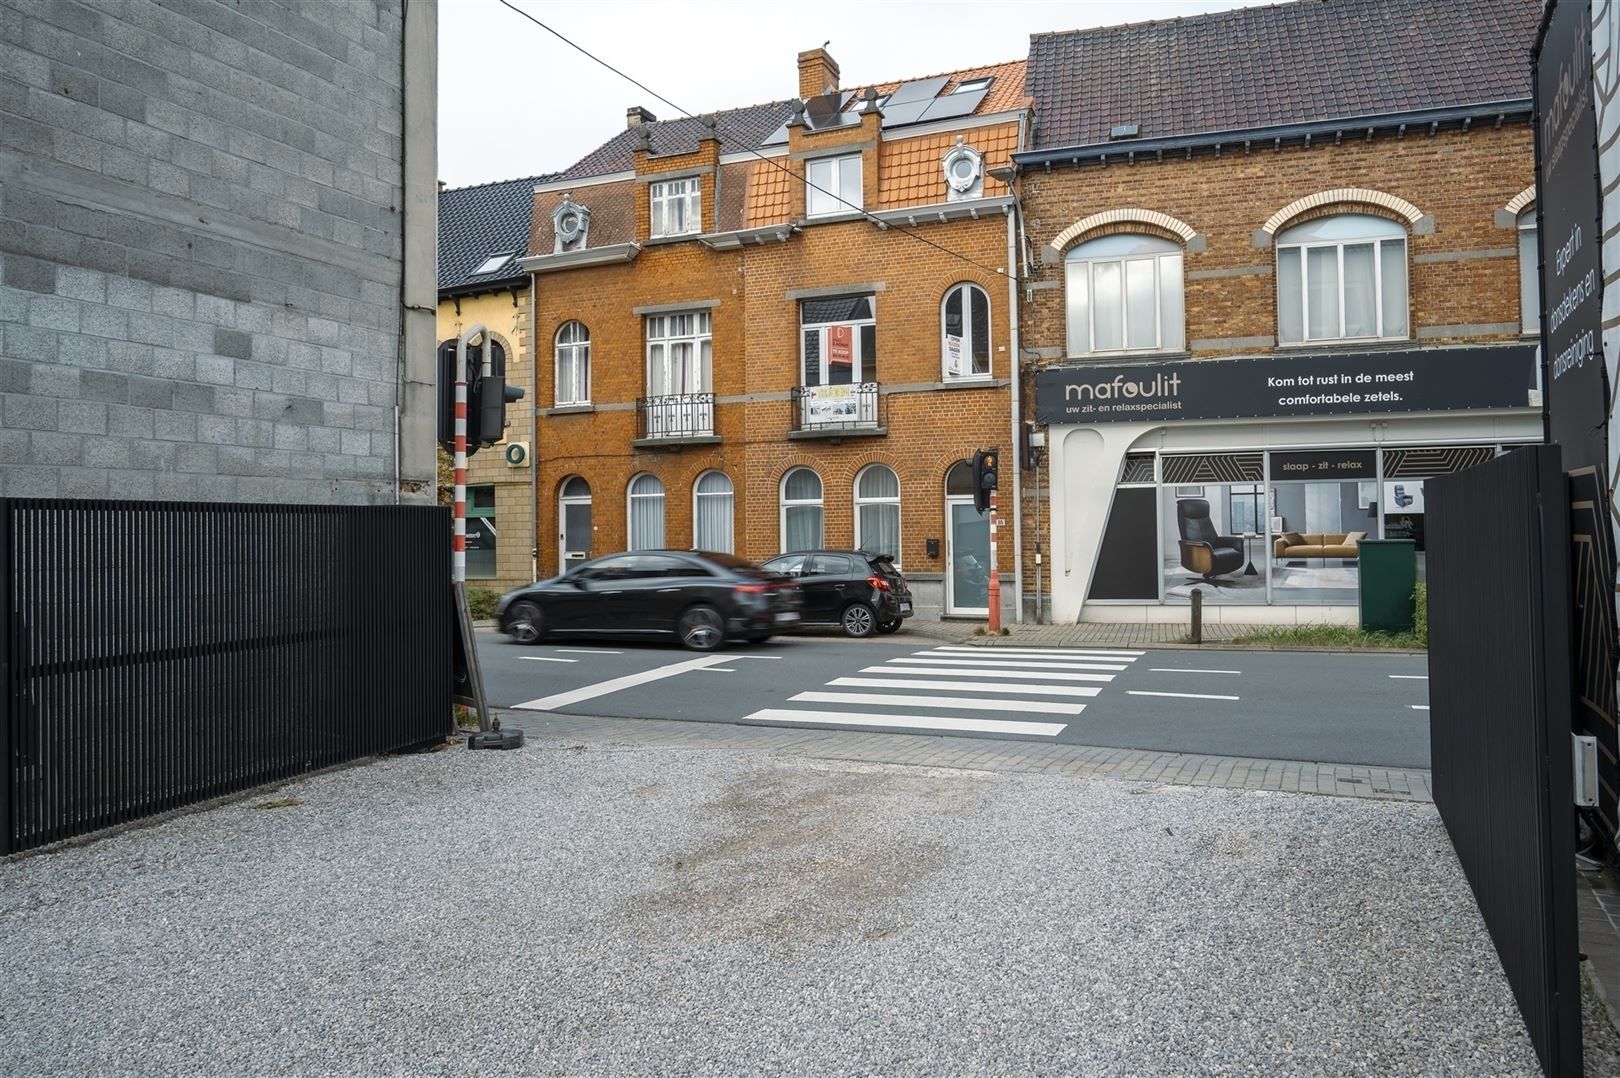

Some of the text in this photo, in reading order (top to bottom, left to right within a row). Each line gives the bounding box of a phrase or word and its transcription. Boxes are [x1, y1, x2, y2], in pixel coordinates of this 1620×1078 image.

[1544, 10, 1586, 154] mafoulit
[1555, 222, 1583, 277] Expert in
[1550, 268, 1596, 334] donsdekens en
[1553, 328, 1595, 380] donsreiniging
[1065, 372, 1182, 401] mafoulit
[1267, 370, 1415, 388] Kom tot rust in de meest
[1066, 401, 1183, 414] uw zit- en relaxspecialist
[1278, 390, 1403, 406] comfortabele zetels.
[1282, 460, 1363, 472] slaap zit relax
